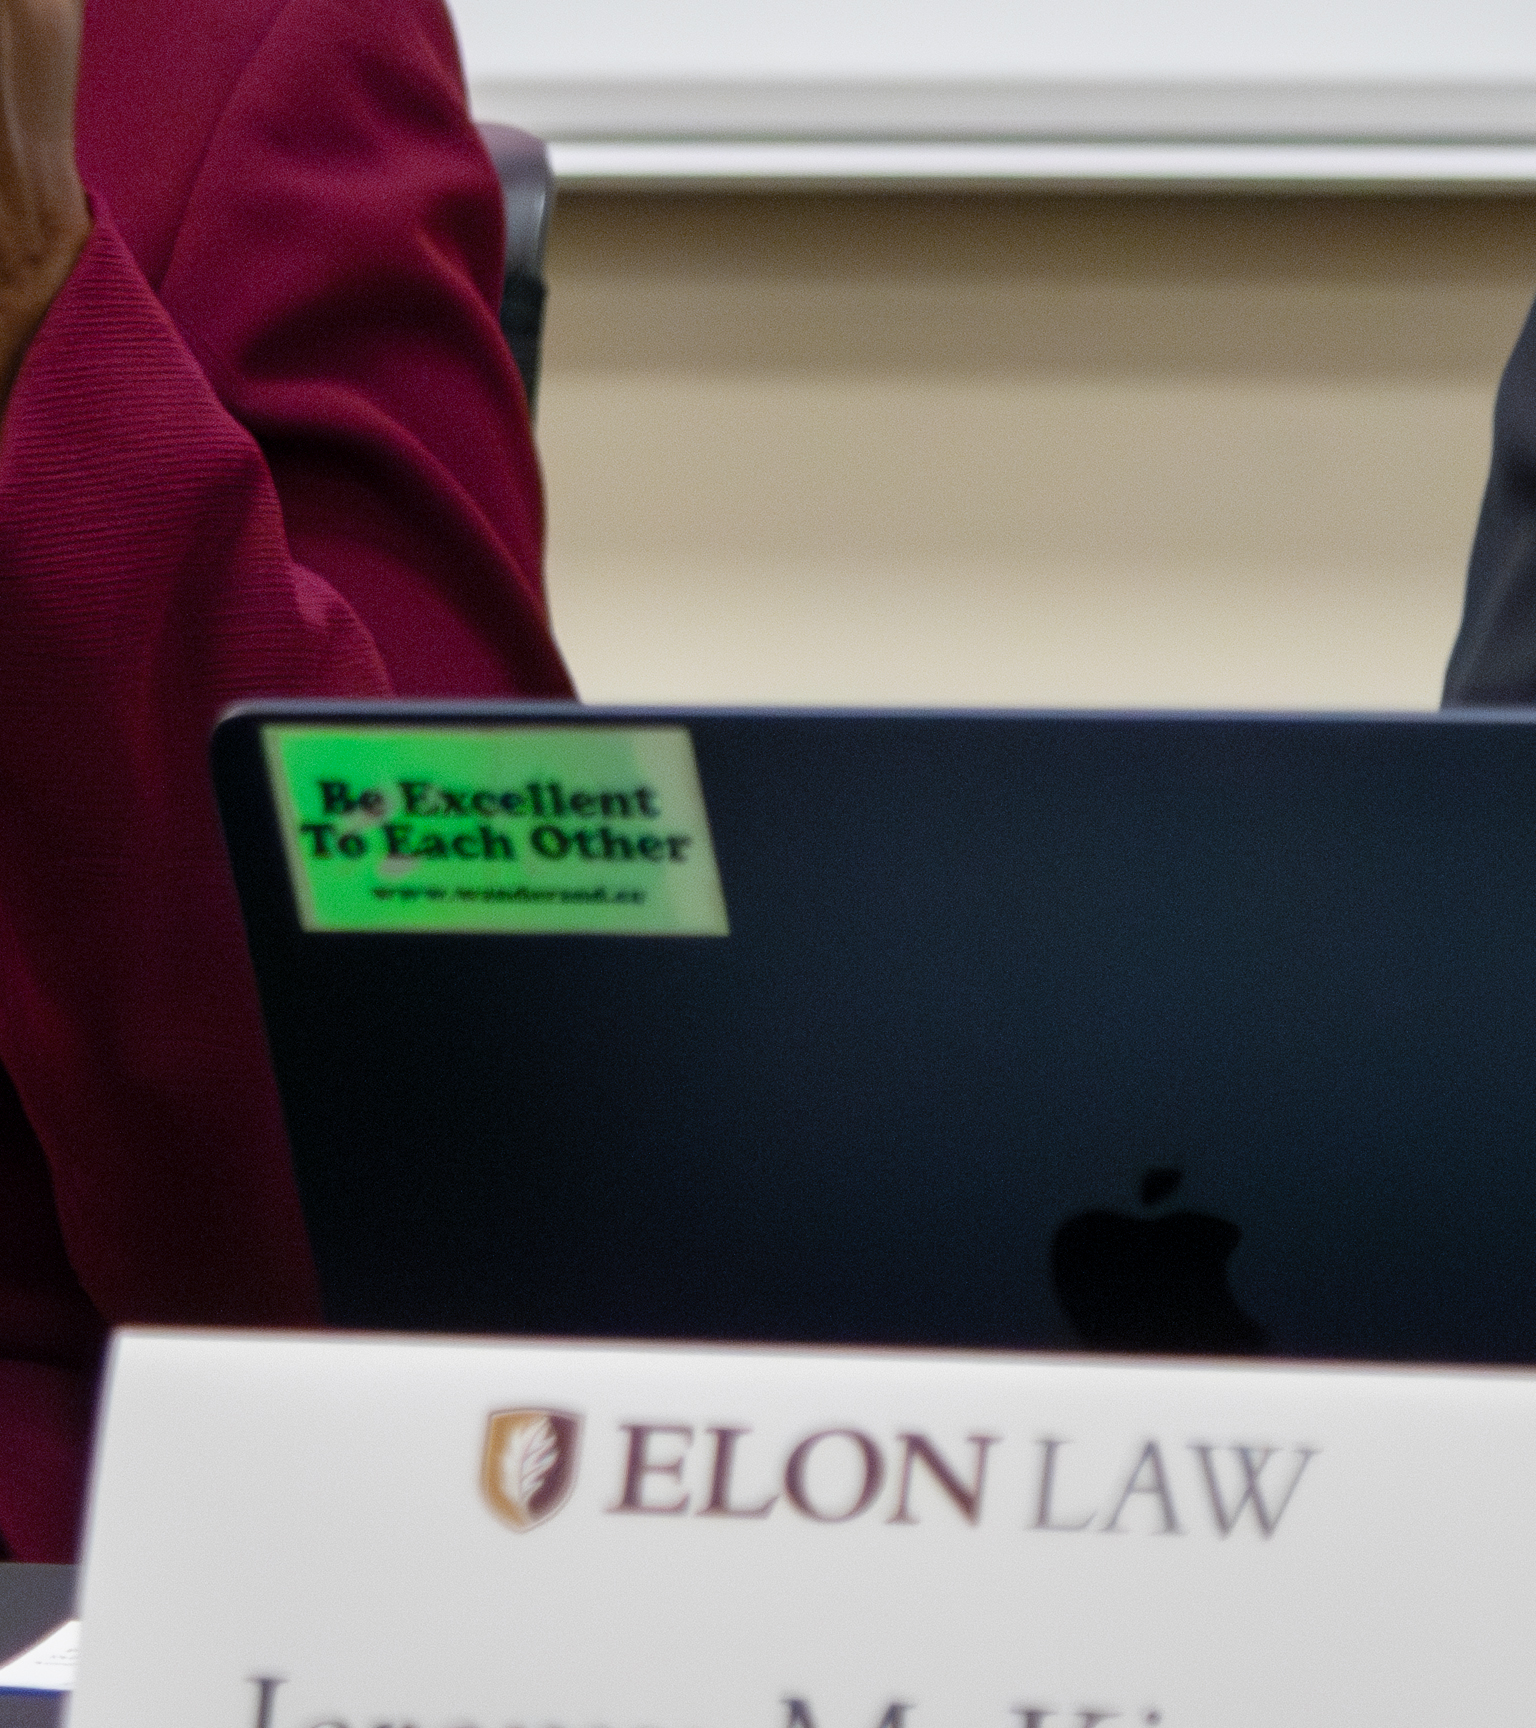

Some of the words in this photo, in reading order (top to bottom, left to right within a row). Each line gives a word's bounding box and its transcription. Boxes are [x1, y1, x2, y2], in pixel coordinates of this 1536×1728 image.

[318, 779, 388, 819] Be
[398, 779, 661, 820] Excellent
[301, 822, 369, 860] To
[382, 823, 514, 860] Each
[530, 823, 691, 863] Other
[602, 1422, 1005, 1529] ELON
[1025, 1435, 1324, 1541] LAW
